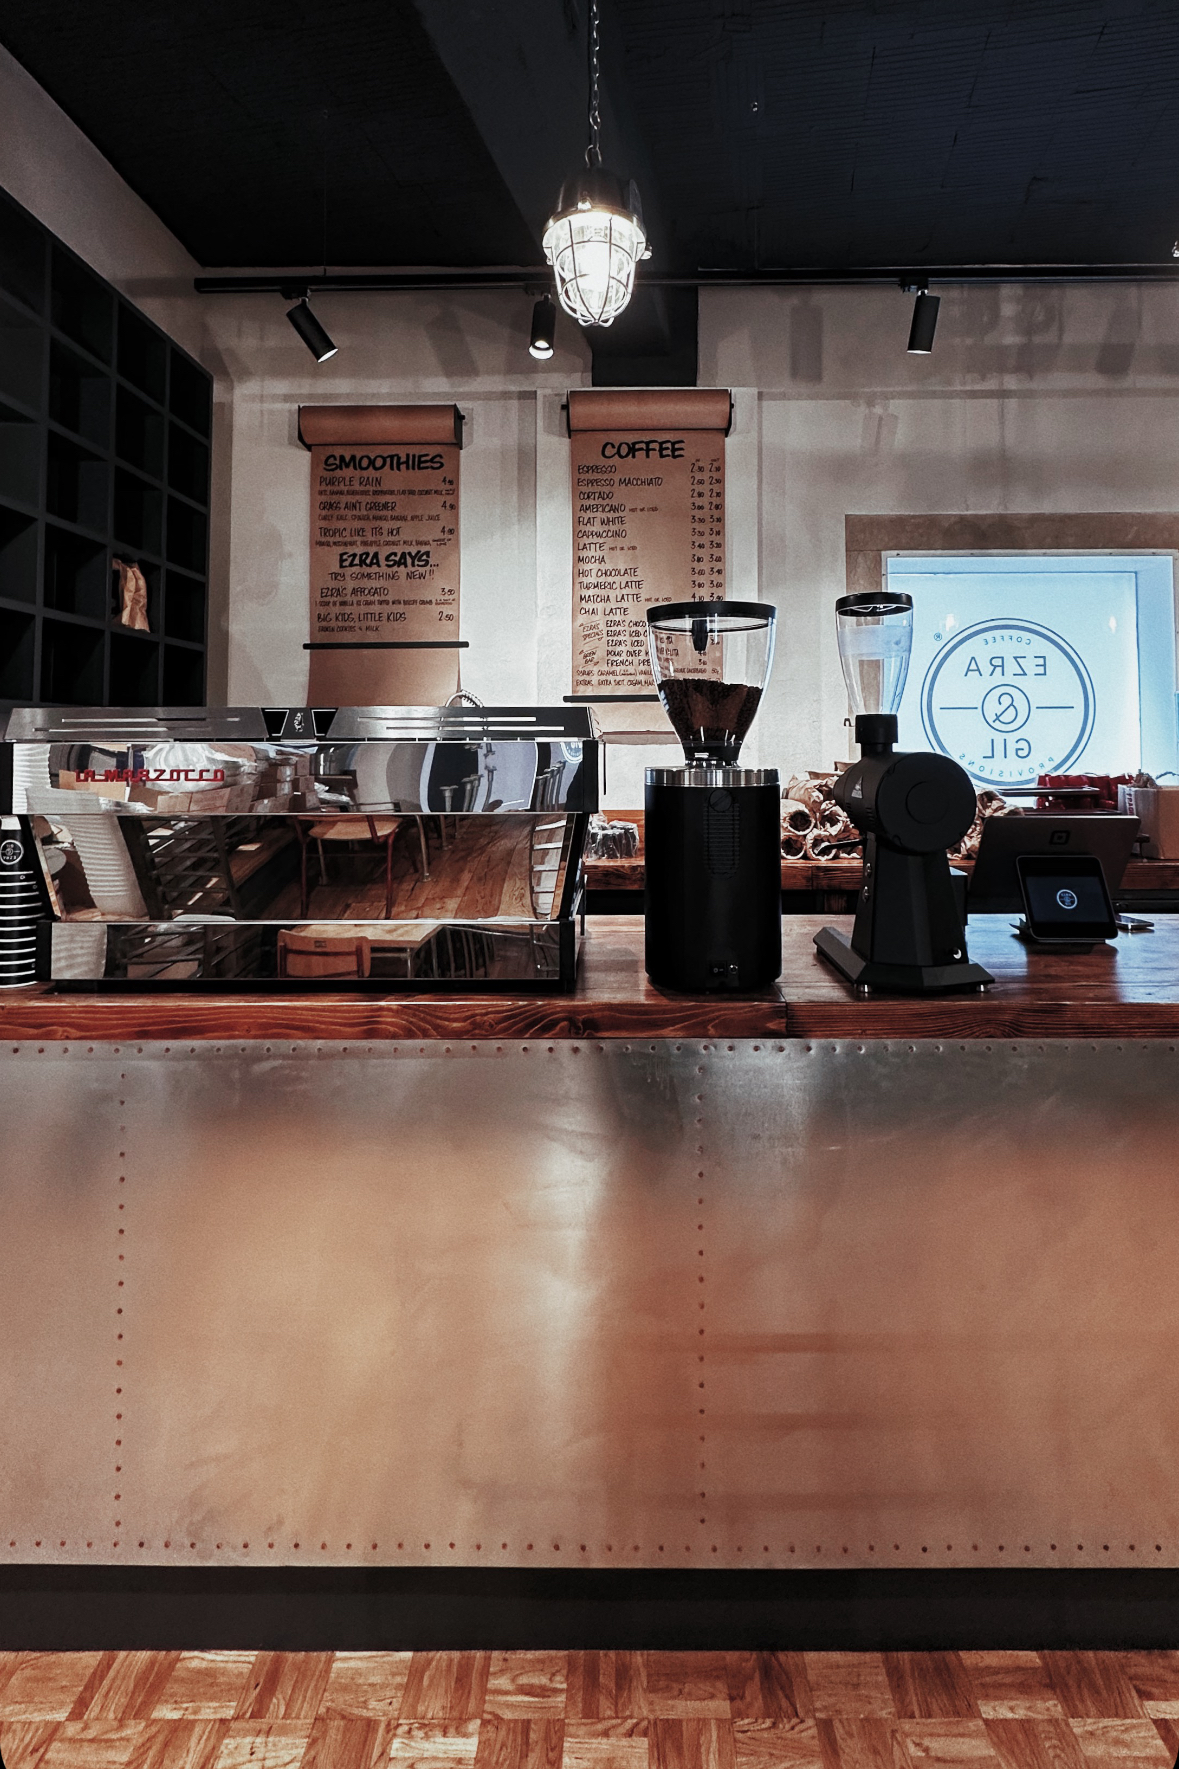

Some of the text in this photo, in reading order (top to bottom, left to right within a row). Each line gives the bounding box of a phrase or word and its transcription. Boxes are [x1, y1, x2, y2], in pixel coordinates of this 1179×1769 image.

[601, 440, 685, 459] COFFEE
[323, 453, 445, 472] SMOOTHIES
[577, 464, 617, 475] ESPRESSO
[319, 476, 355, 487] PURPLE
[358, 476, 382, 487] RAIN
[577, 477, 615, 487] ESPRESSO
[618, 476, 663, 487] MACCHIATO
[578, 490, 614, 501] CORTADO
[318, 501, 341, 511] GRASS
[343, 501, 363, 511] AIN'T
[365, 501, 397, 511] GREENER
[579, 503, 626, 514] AMERICANO
[577, 515, 597, 527] FLAT
[600, 515, 627, 526] WHITE
[318, 526, 347, 538] TROPIC
[349, 526, 367, 537] LIKE
[387, 526, 402, 537] HOT
[577, 528, 627, 539] CAPPUCCINO
[577, 541, 607, 552] LATTE
[338, 550, 439, 568] EZRA SAYS...
[577, 554, 606, 565] MOCHA
[328, 572, 346, 582] TRY
[350, 570, 400, 581] SOMETHING
[577, 567, 594, 578] HOT
[596, 566, 639, 578] CHOCOLATE
[578, 580, 618, 591] TURMERIC
[619, 580, 645, 590] LATTE
[320, 586, 348, 598] EZRA'S
[350, 586, 389, 597] AFFOGATO
[579, 593, 611, 604] MATCHA
[615, 593, 642, 603] LATTE
[317, 612, 332, 623] BIG
[358, 612, 383, 622] LITTLE
[386, 612, 406, 622] KIDS
[579, 607, 629, 617] CHAI LATTE
[582, 623, 600, 632] EZRA'S
[605, 620, 626, 628] EZRA'S
[606, 629, 627, 638] EZRA'S
[606, 639, 628, 648] EZRA'S
[606, 649, 624, 658] POUR
[626, 649, 641, 658] OVER
[606, 659, 651, 667] FRENCH PRE
[103, 768, 225, 783] MARZOCCO
